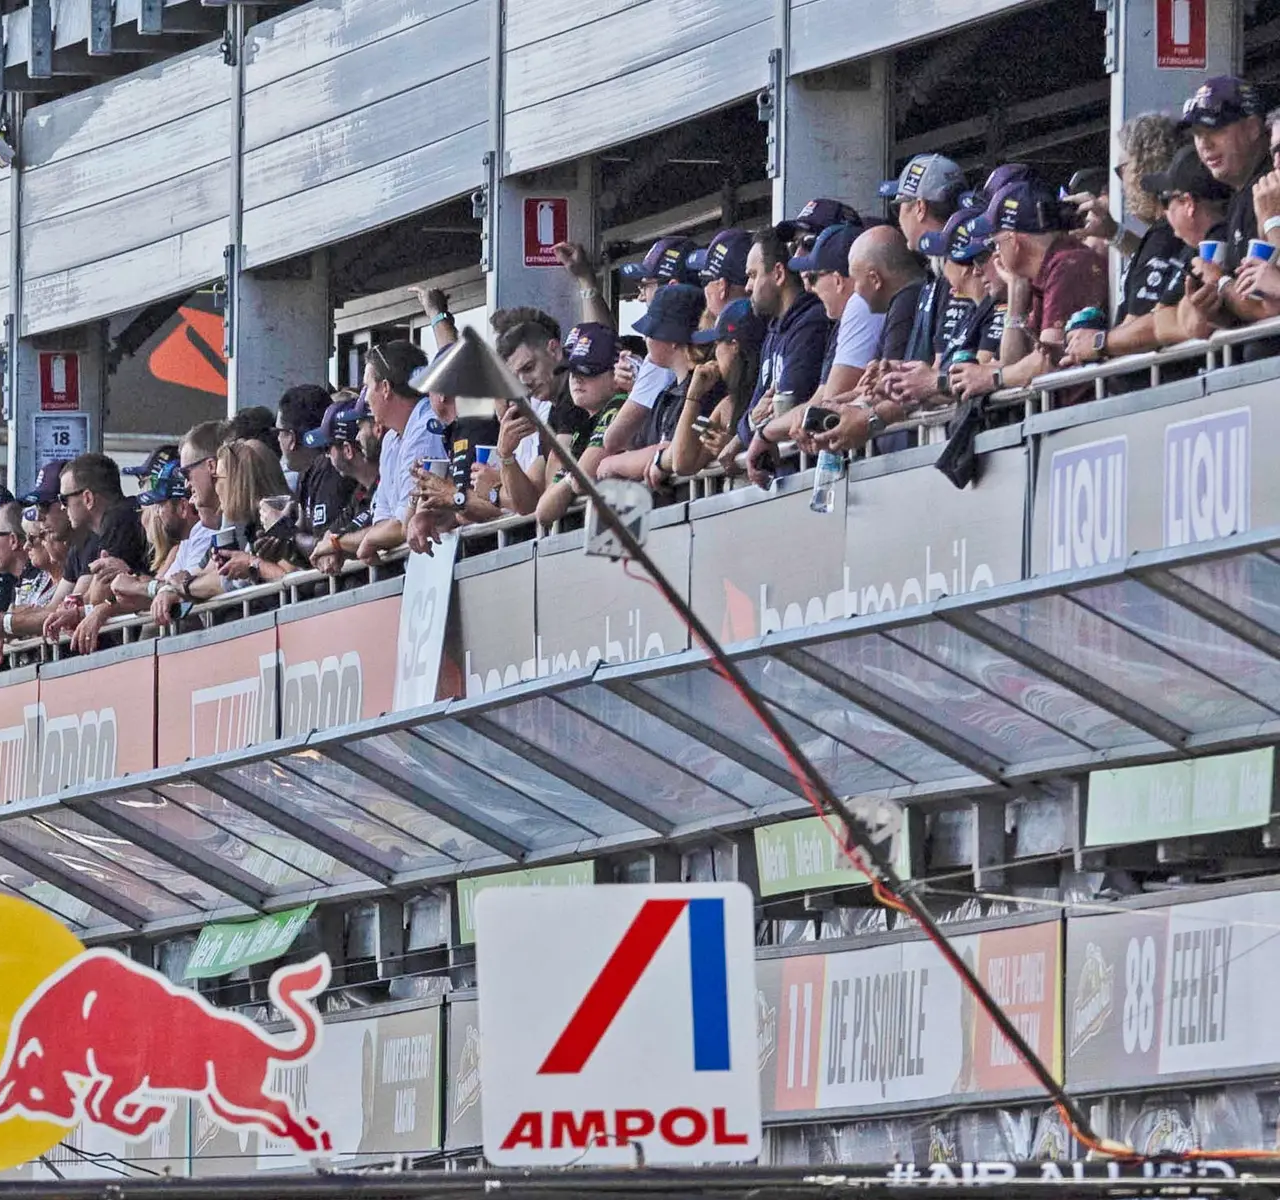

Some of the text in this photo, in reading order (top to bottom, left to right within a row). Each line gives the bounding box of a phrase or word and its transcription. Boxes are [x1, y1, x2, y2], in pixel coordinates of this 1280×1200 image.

[1053, 450, 1125, 573] LIQUI
[786, 982, 812, 1089] 11
[827, 979, 850, 1085] DE
[853, 969, 928, 1098] PASQUALE
[1123, 937, 1157, 1054] 88
[1168, 925, 1233, 1047] FEENEY
[499, 1107, 749, 1150] AMPOL
